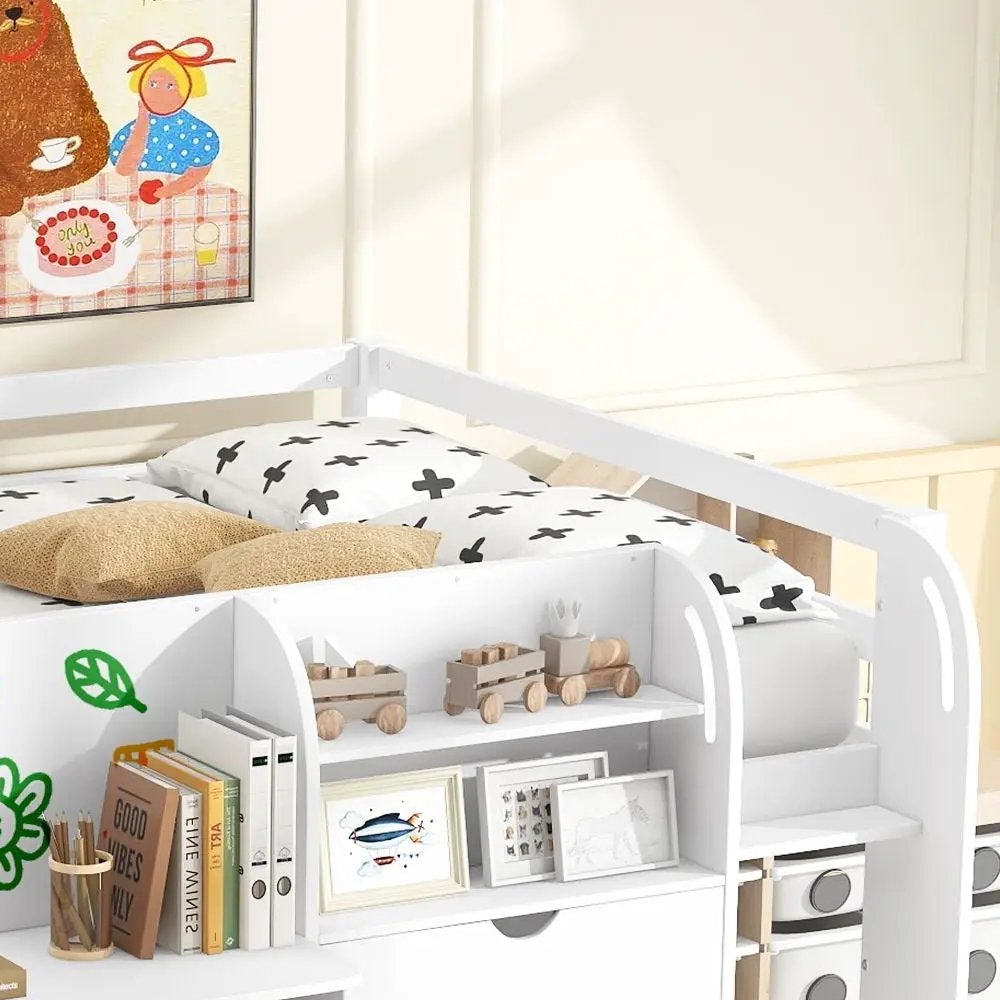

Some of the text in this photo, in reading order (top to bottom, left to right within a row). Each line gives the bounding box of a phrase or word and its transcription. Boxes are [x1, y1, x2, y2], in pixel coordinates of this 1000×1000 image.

[58, 220, 89, 241] only
[67, 238, 96, 255] you
[113, 798, 147, 840] GOOD
[108, 837, 143, 882] VIBES
[110, 884, 134, 923] NLY
